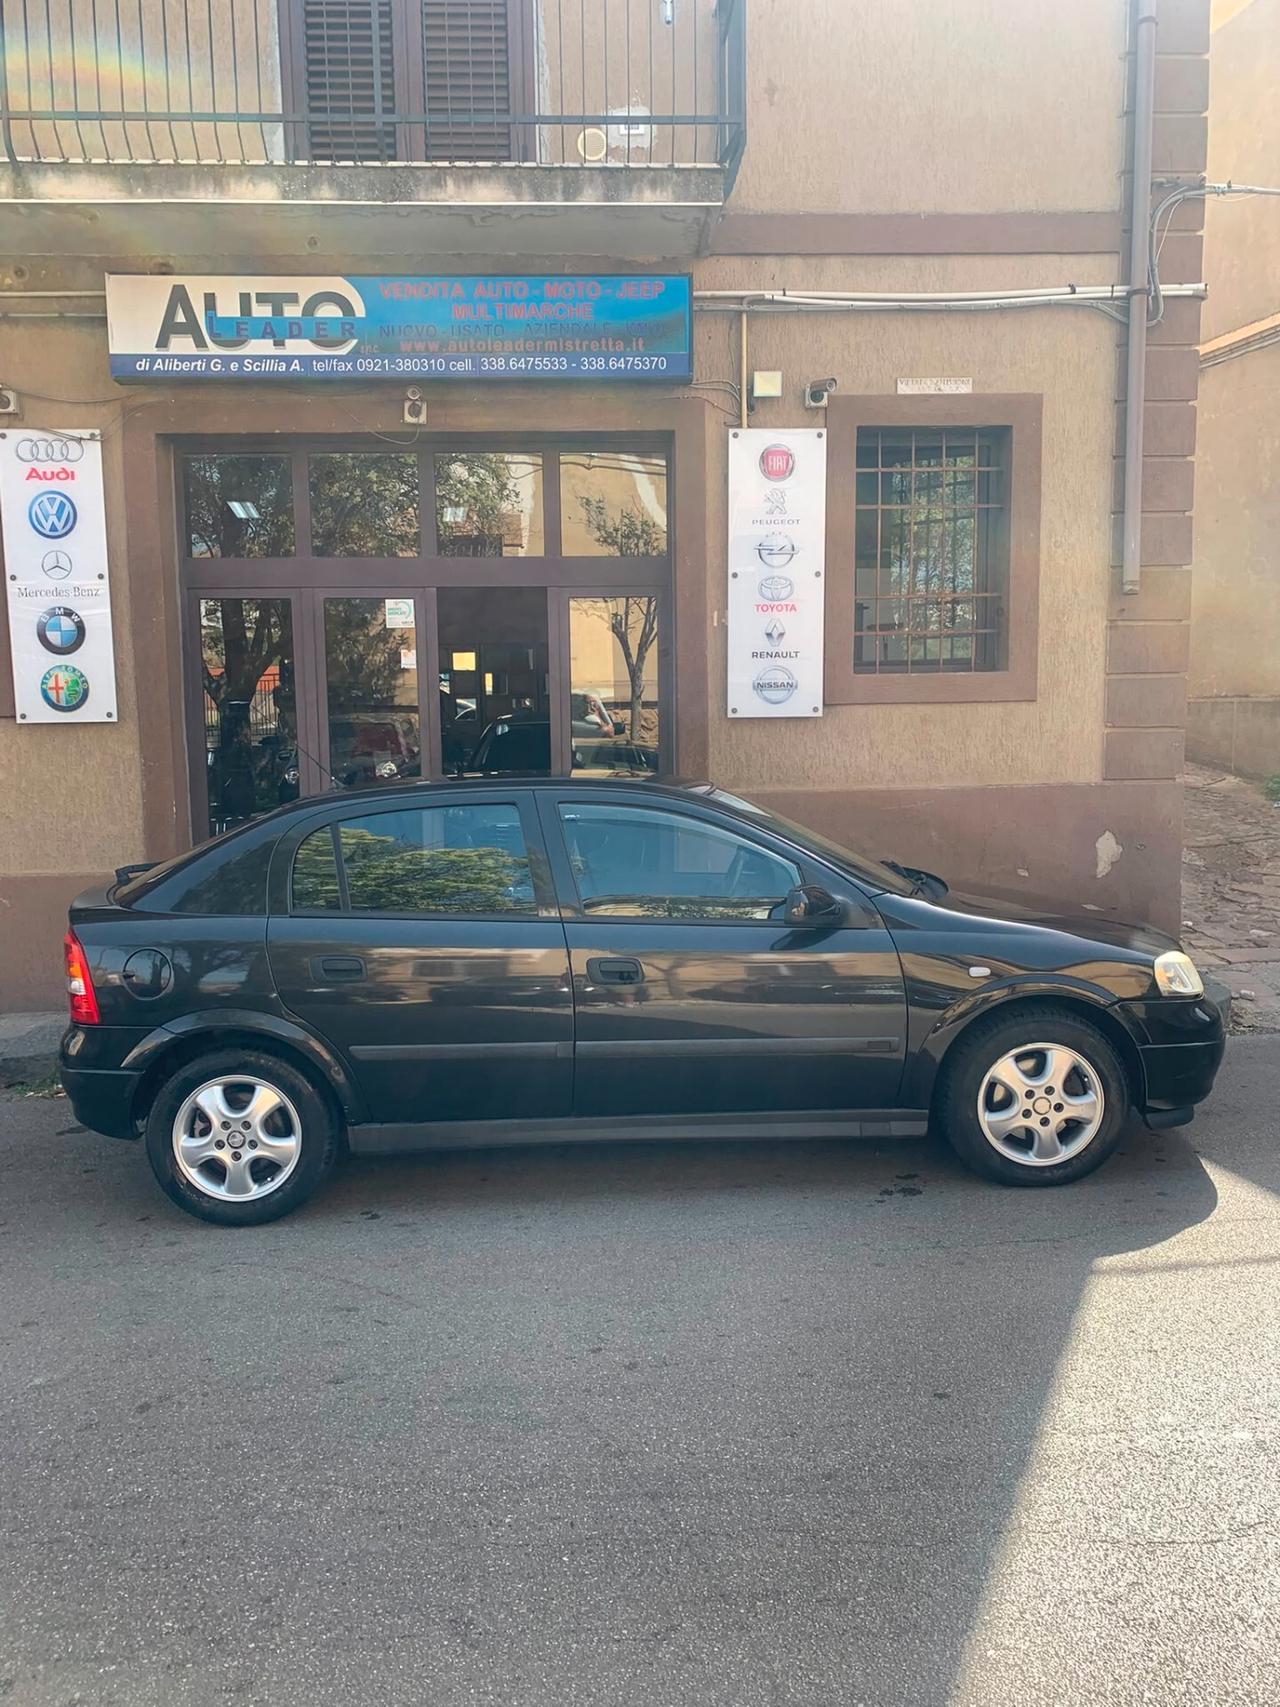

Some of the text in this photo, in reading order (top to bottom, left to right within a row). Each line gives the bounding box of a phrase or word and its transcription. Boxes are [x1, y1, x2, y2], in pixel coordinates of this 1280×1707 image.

[379, 282, 464, 299] VENDITA
[474, 282, 528, 299] AUTO
[544, 282, 600, 299] MOTO
[616, 281, 664, 298] JEEP
[155, 284, 358, 351] AUTO
[452, 303, 593, 320] MULTIMARCHE
[207, 310, 357, 339] LEADER
[379, 323, 437, 338] NUOVO
[450, 322, 505, 337] USATO
[399, 339, 645, 353] www.autoleadermistretta.it
[136, 358, 150, 372] di
[153, 358, 207, 372] Aliberti
[210, 358, 226, 372] G.
[230, 362, 239, 372] e
[243, 358, 286, 372] Scillia
[290, 358, 305, 372] A.
[313, 357, 353, 372] tel/fax
[357, 357, 445, 371] 0921-380310
[450, 357, 475, 371] cell.
[480, 356, 568, 371] 338.6475533
[580, 356, 667, 370] 338.6475370
[768, 455, 788, 471] FIAT
[25, 467, 75, 481] Audi
[752, 518, 800, 526] PEUGEOT
[41, 607, 80, 623] BMW
[754, 604, 797, 613] TOYOTA
[752, 651, 800, 659] RENAULT
[757, 681, 794, 690] NISSAN
